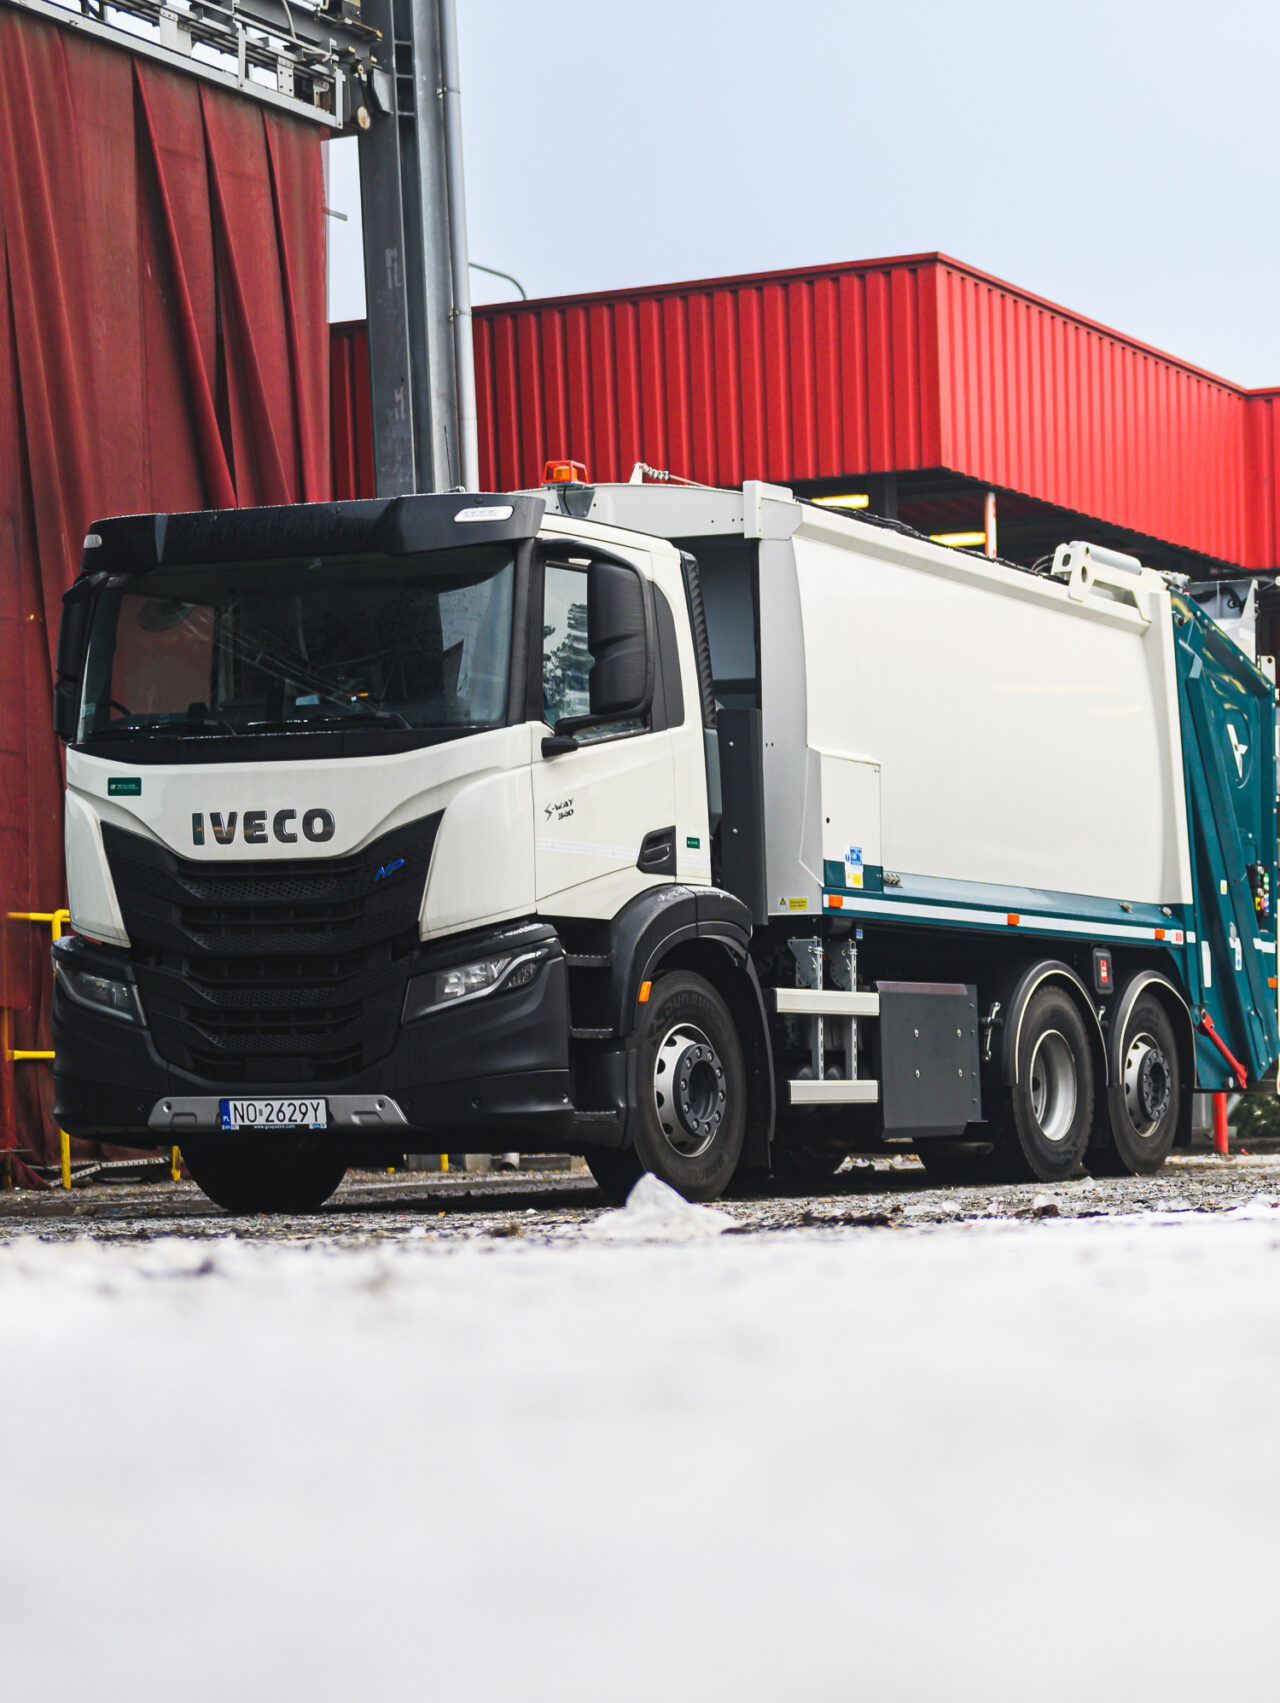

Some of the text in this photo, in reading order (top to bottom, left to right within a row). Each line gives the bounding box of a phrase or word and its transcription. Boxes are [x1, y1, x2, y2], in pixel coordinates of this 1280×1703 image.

[192, 808, 336, 846] IVECO
[233, 1102, 320, 1123] NO 2629Y
